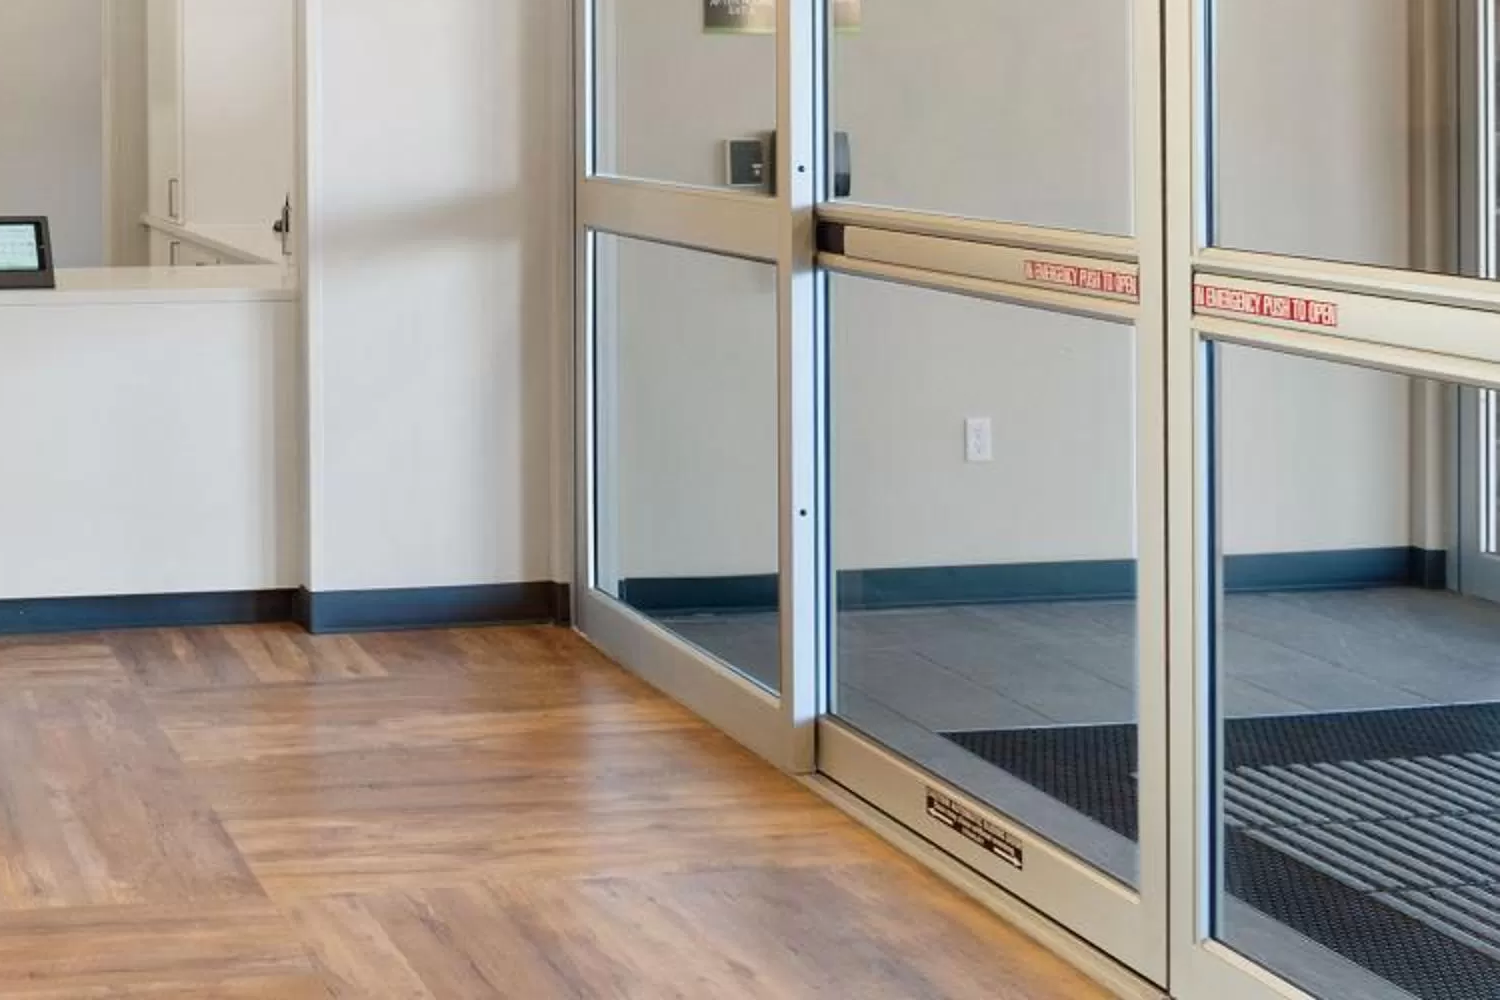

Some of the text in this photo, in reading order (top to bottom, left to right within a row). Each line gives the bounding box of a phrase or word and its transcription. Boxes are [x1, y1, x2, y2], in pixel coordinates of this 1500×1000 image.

[1035, 262, 1079, 286] EMERGENCY
[1079, 268, 1101, 290] PUSH
[1103, 272, 1114, 291] TO
[1115, 274, 1137, 295] OPEN
[1205, 287, 1261, 314] EMERGENCY
[1263, 294, 1290, 317] PUSH
[1292, 299, 1307, 321] TO
[1307, 301, 1336, 325] OPEN
